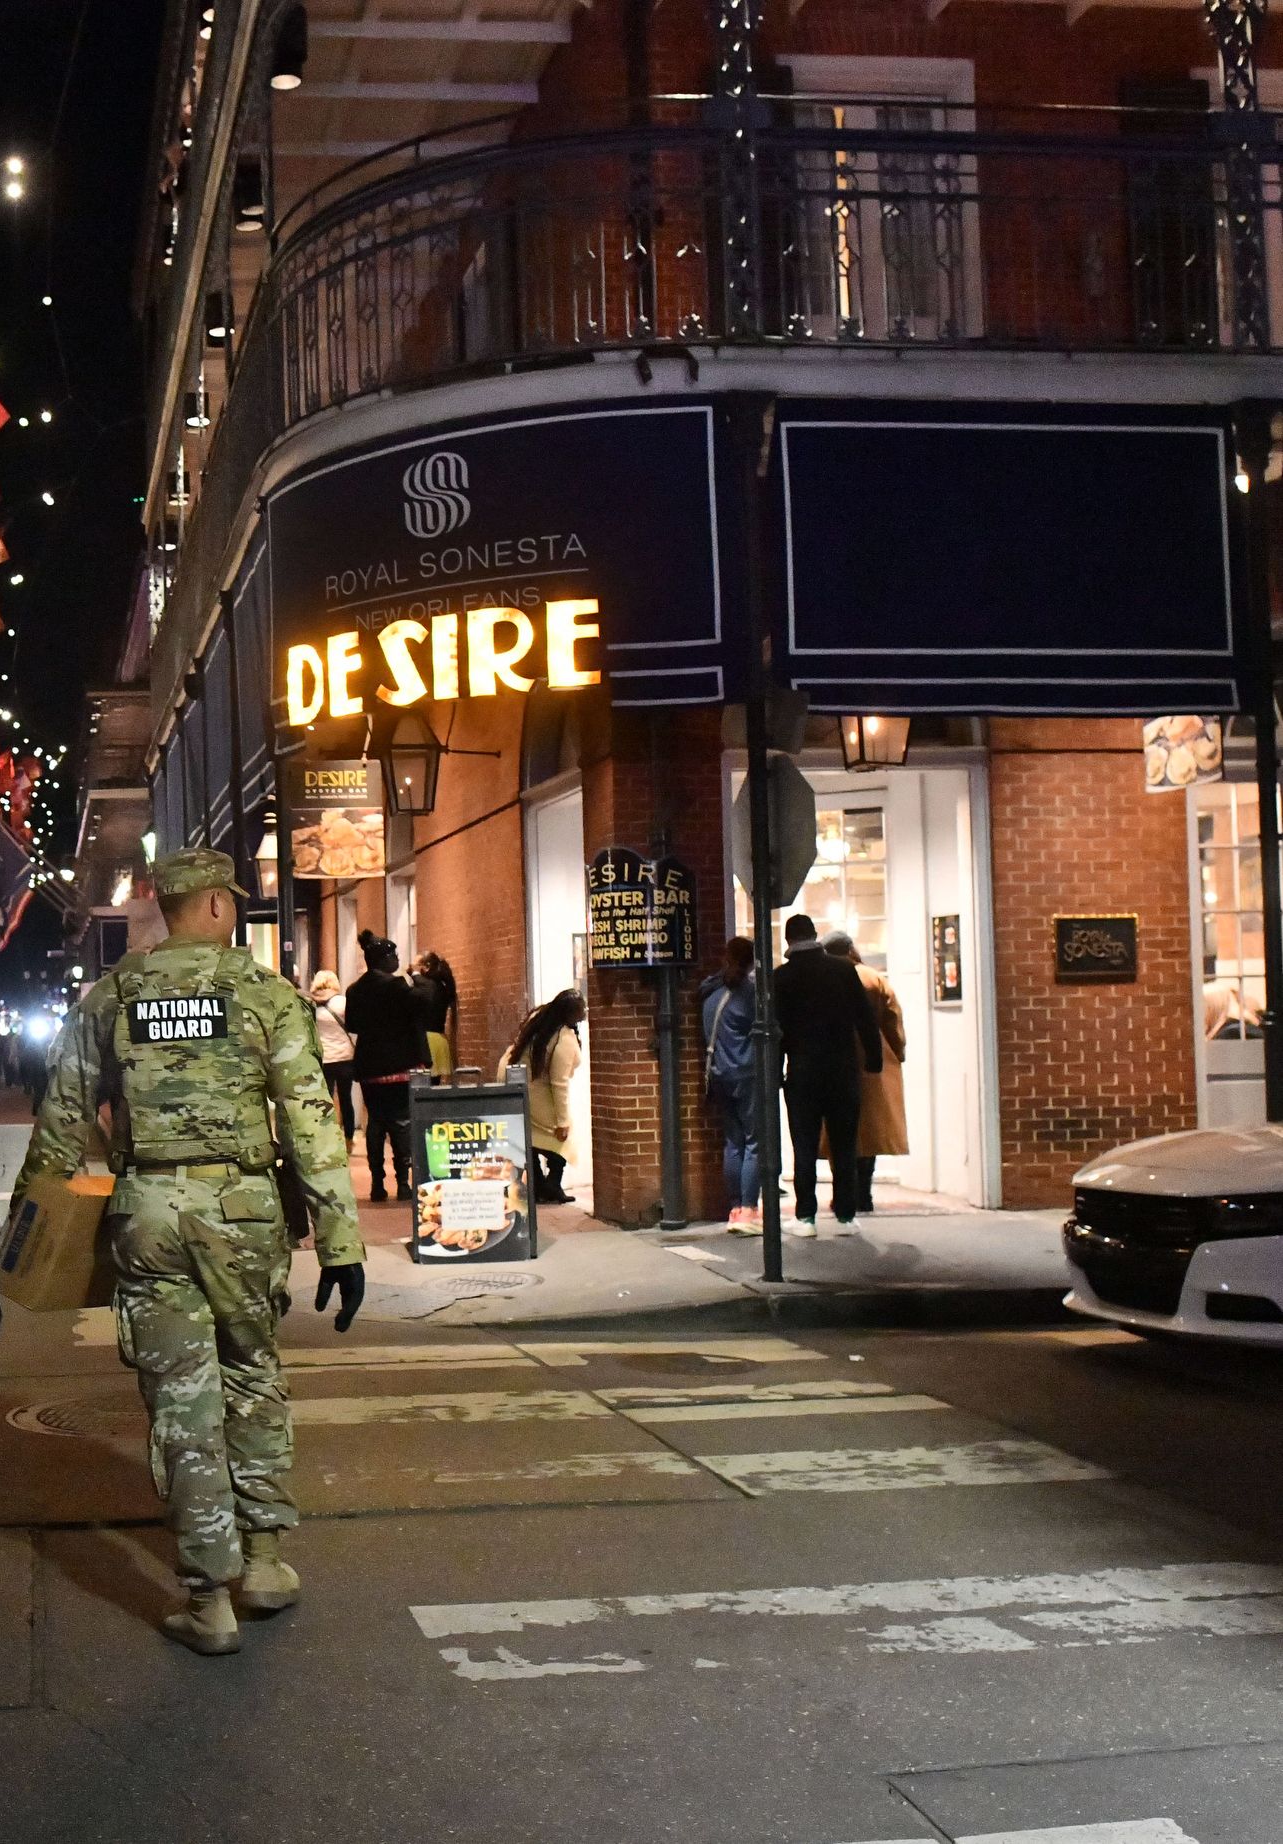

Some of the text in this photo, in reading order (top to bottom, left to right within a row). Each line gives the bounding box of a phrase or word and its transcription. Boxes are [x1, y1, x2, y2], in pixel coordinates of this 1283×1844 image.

[325, 532, 587, 600] ROYAL SONESTA
[355, 586, 541, 631] NEW ORLEANS
[286, 598, 601, 726] DESIRE
[304, 769, 368, 787] DESIRE
[589, 862, 684, 891] ESIRE
[590, 888, 691, 909] OYSTER BAR
[593, 918, 668, 933] ESH SHRIMP
[684, 908, 693, 960] LIQUOR
[619, 931, 669, 946] GUMBO
[137, 999, 224, 1020] NATIONAL
[148, 1018, 213, 1040] GUARD
[432, 1121, 509, 1142] DESIRE
